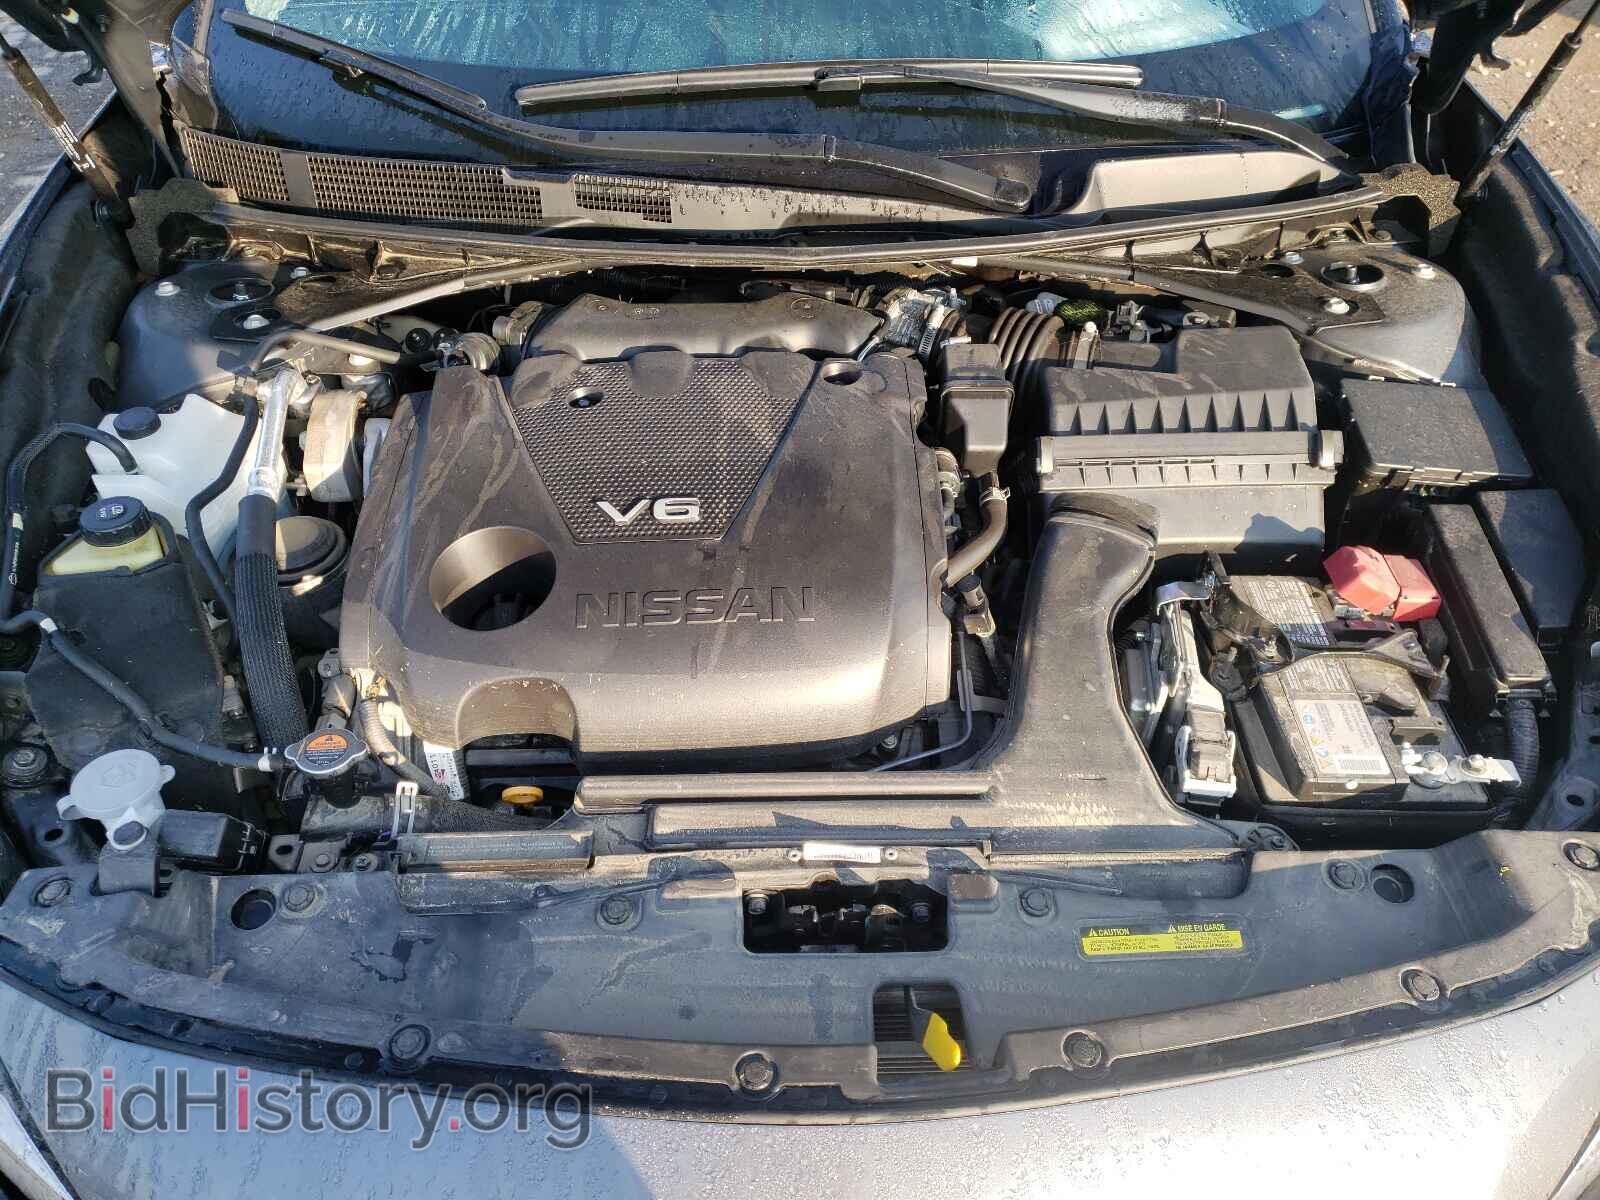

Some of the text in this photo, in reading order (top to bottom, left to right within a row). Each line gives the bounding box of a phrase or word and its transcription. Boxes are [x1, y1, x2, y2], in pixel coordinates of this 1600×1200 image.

[596, 497, 701, 526] V6
[576, 586, 815, 629] NISSAN
[1098, 927, 1131, 937] CAUTION
[1177, 924, 1194, 933] MISE
[1203, 923, 1227, 932] GARDE
